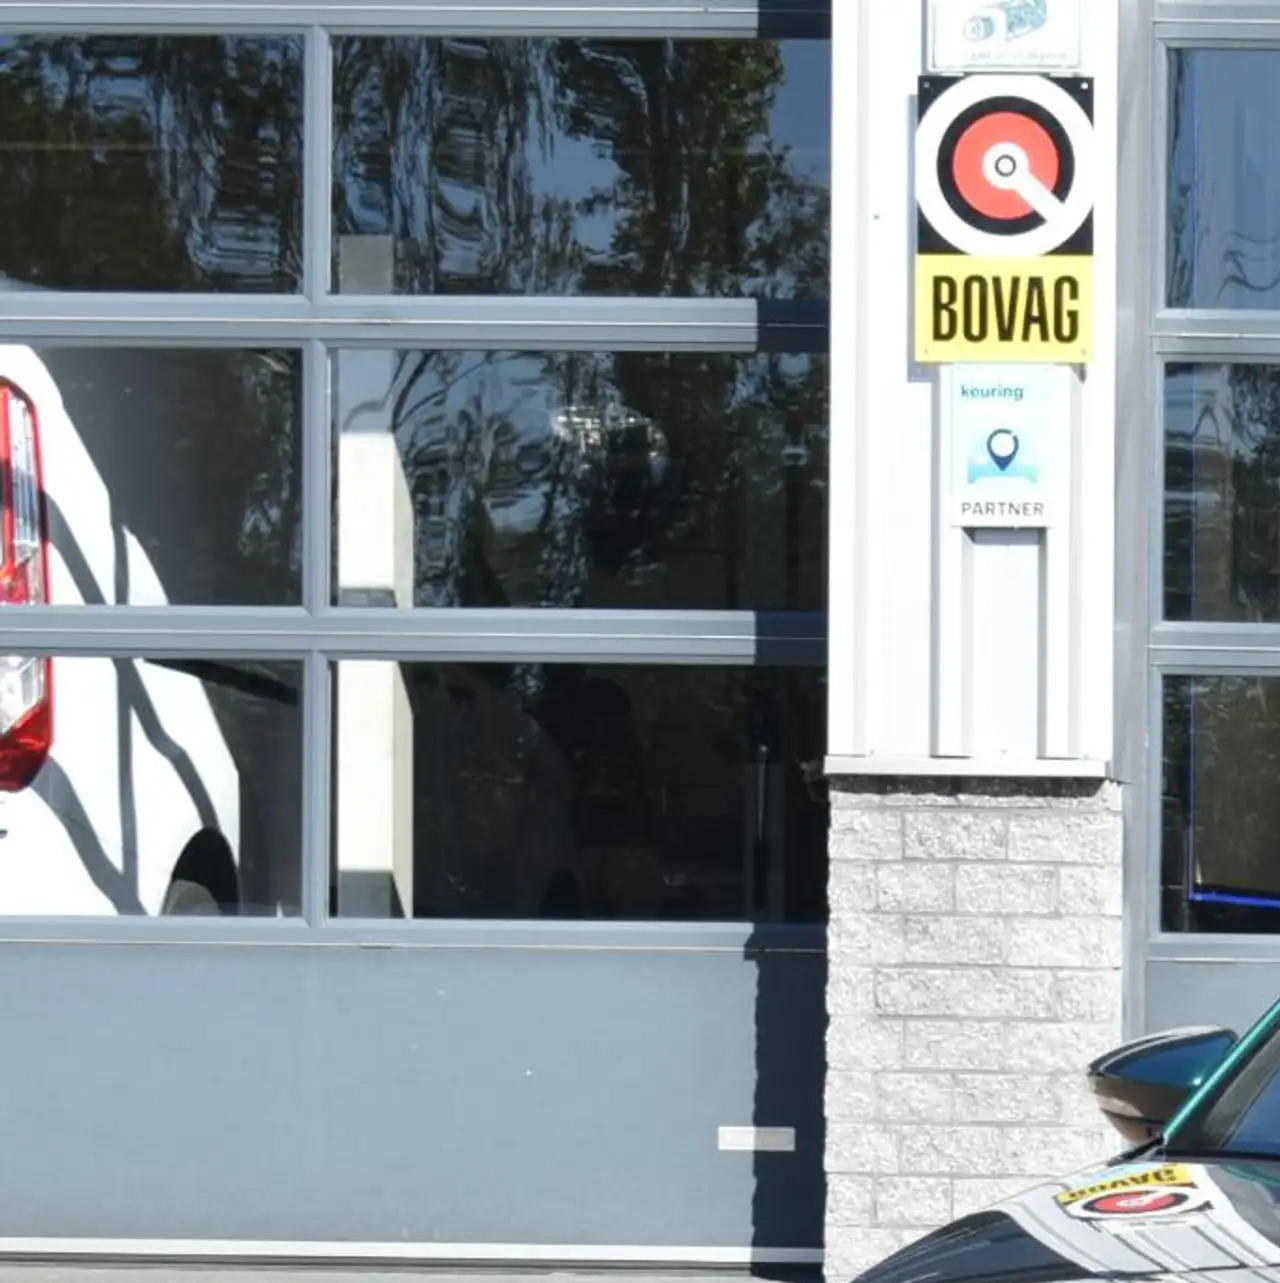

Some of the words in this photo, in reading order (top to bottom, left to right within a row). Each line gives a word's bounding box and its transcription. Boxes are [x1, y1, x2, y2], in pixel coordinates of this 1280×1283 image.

[932, 274, 1079, 344] BOVAG
[961, 384, 1024, 401] keuring
[961, 501, 1044, 516] PARTNER
